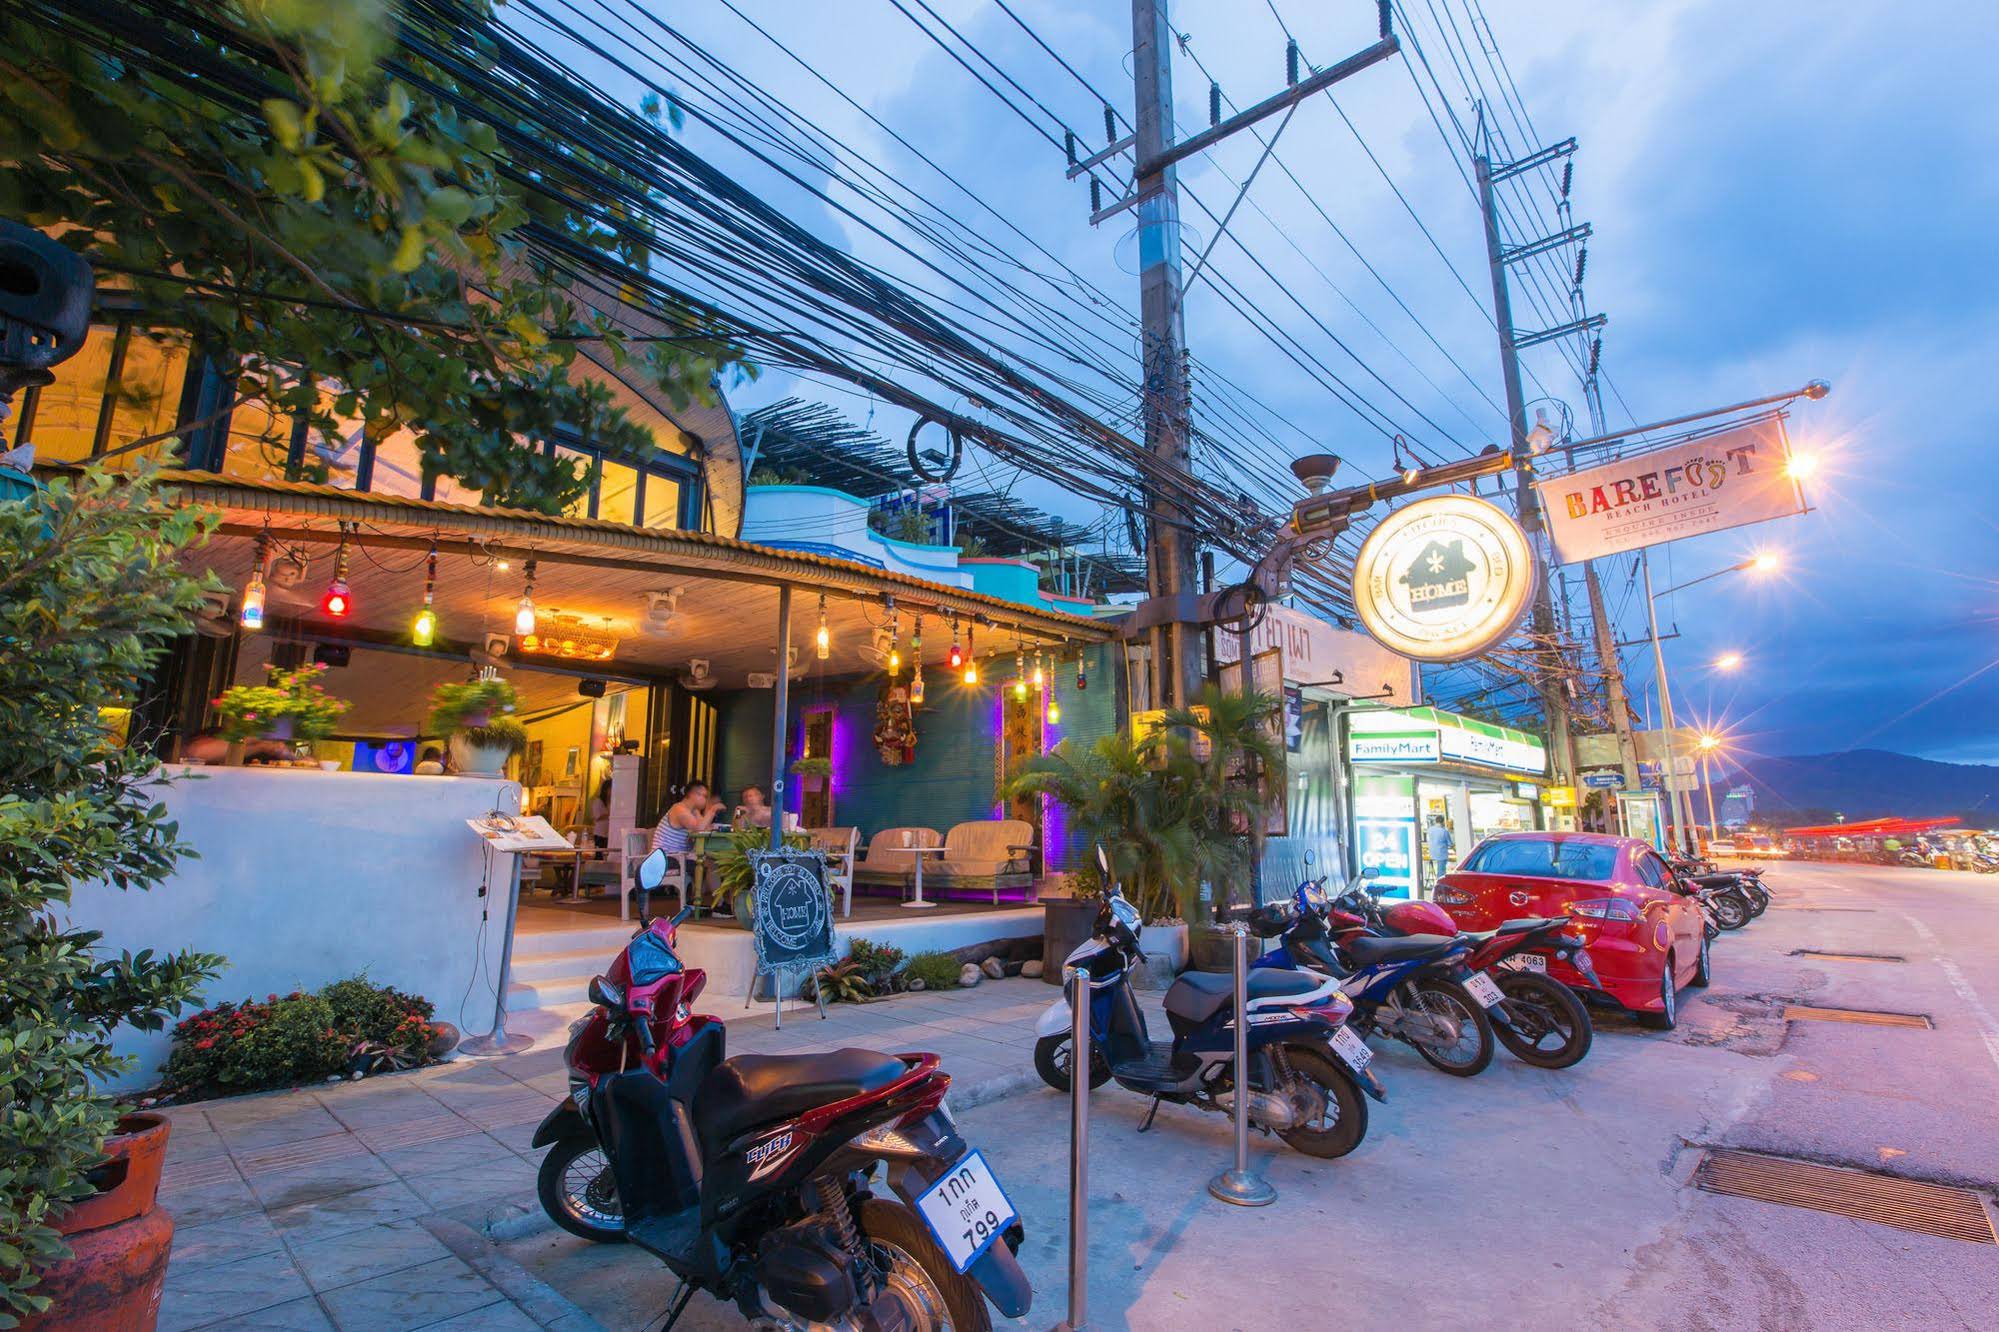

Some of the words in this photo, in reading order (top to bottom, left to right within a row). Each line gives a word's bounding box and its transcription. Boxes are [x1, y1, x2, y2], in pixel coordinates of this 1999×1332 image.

[1606, 502, 1651, 520] BEACH
[1661, 488, 1710, 507] HOTEL
[1409, 578, 1468, 603] HOME
[1355, 742, 1431, 756] FamilyMart
[781, 905, 808, 920] HOME
[766, 919, 798, 947] WELCOME
[1521, 955, 1544, 966] 4063
[938, 1167, 976, 1207] 1กก
[962, 1210, 1000, 1251] 799
